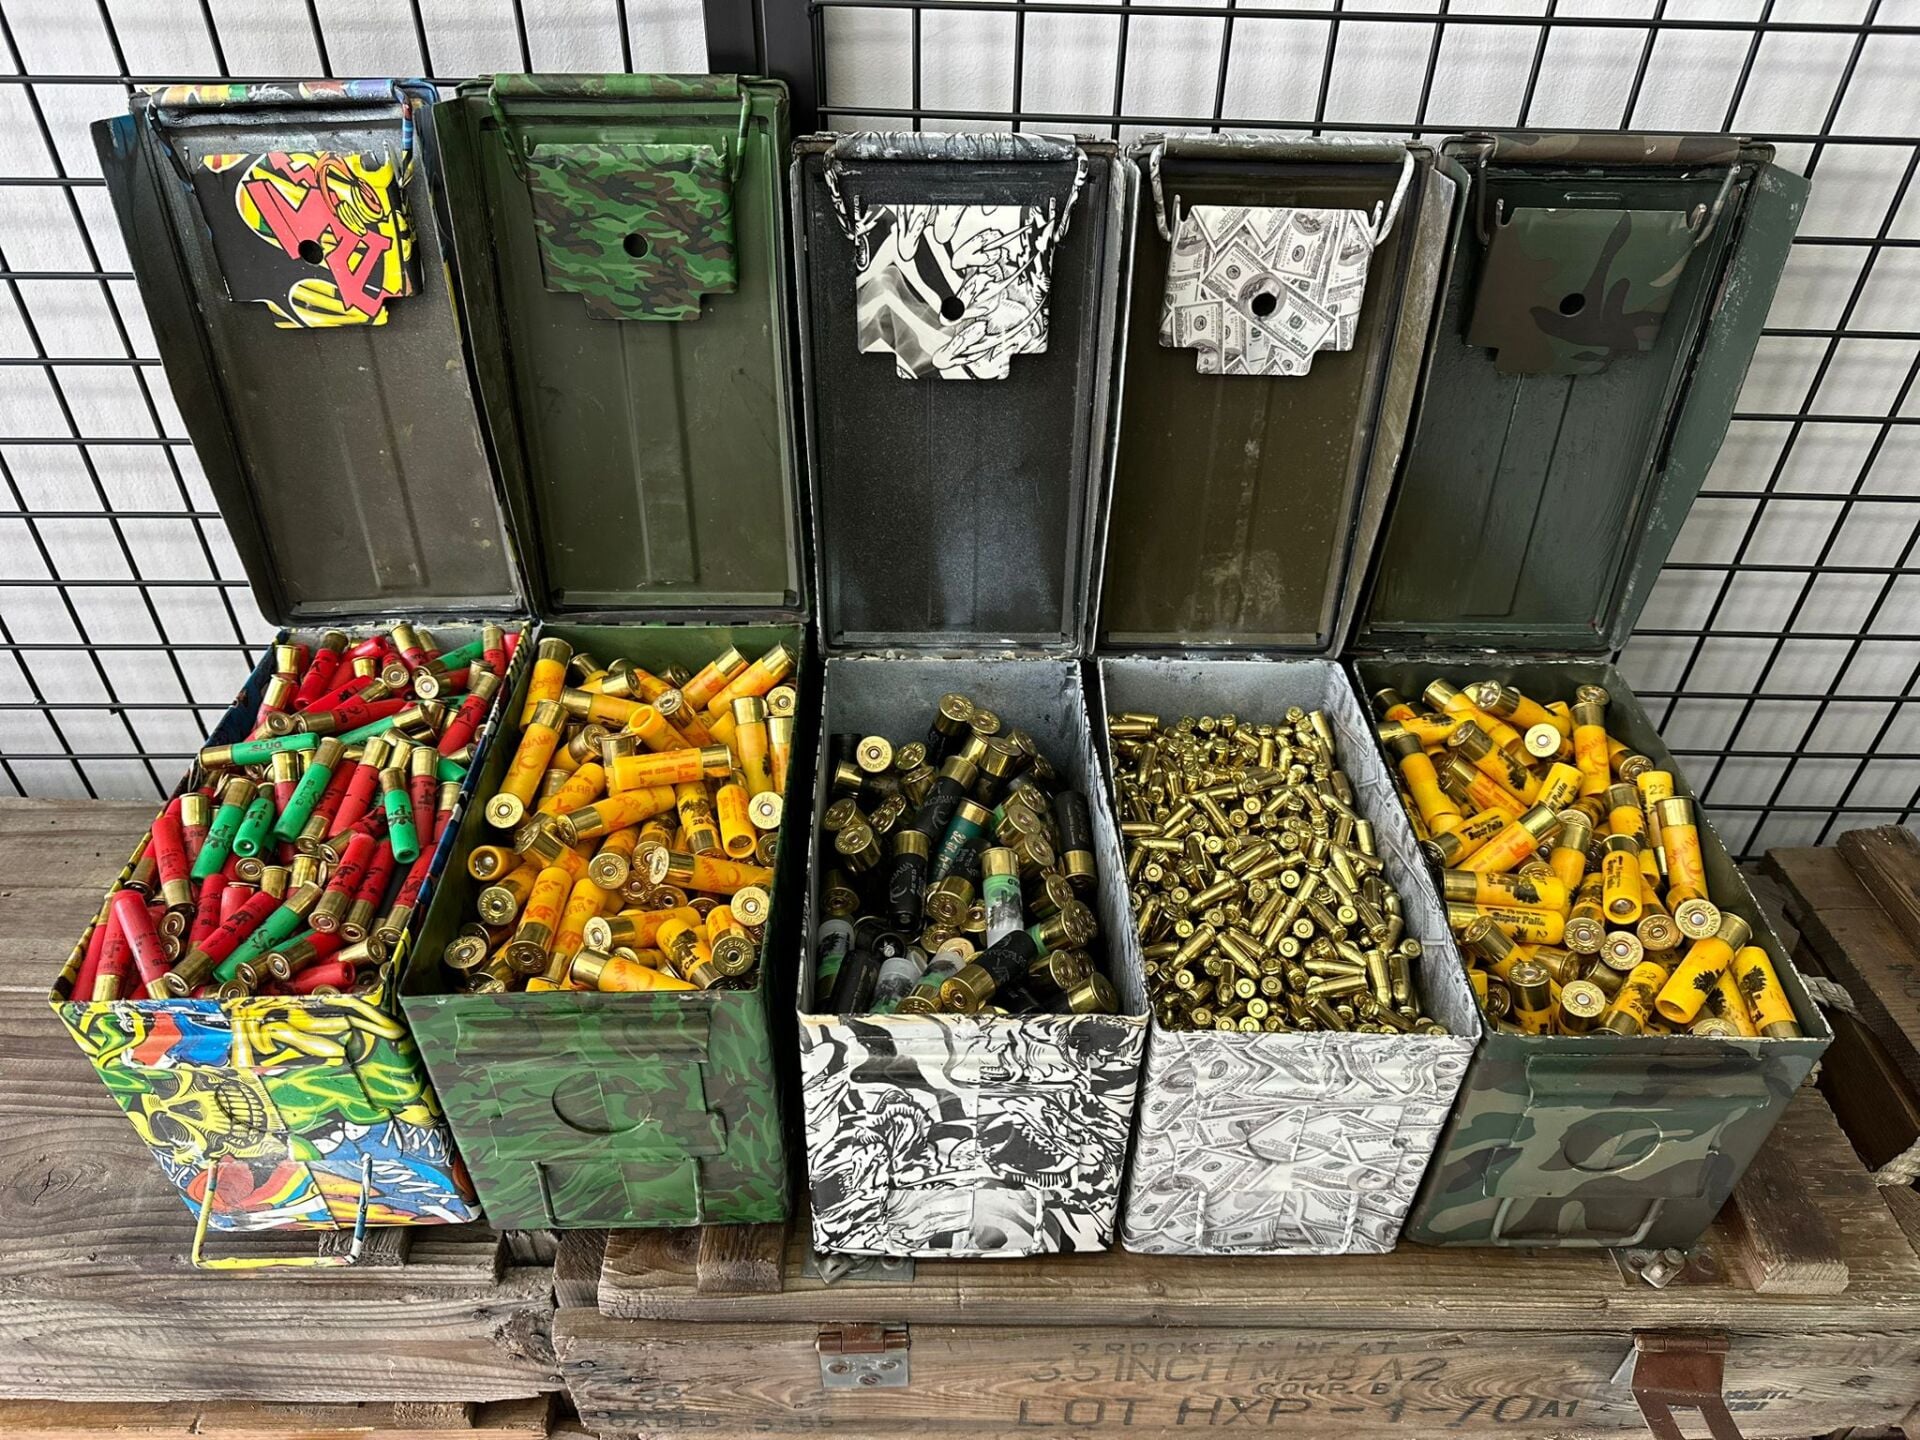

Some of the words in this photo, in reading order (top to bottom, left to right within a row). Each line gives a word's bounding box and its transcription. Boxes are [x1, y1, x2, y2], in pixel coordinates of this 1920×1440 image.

[251, 741, 282, 752] SLUG
[1649, 784, 1666, 795] 22
[1492, 911, 1520, 924] Super
[1521, 916, 1546, 927] Palla
[1073, 1342, 1091, 1355] 3
[1104, 1341, 1275, 1356] ROCKETS
[1029, 1359, 1101, 1382] 3.5
[1114, 1357, 1237, 1382] INCH
[1256, 1382, 1354, 1395] COMP.
[1370, 1382, 1390, 1395] B
[1018, 1397, 1152, 1426] LOT
